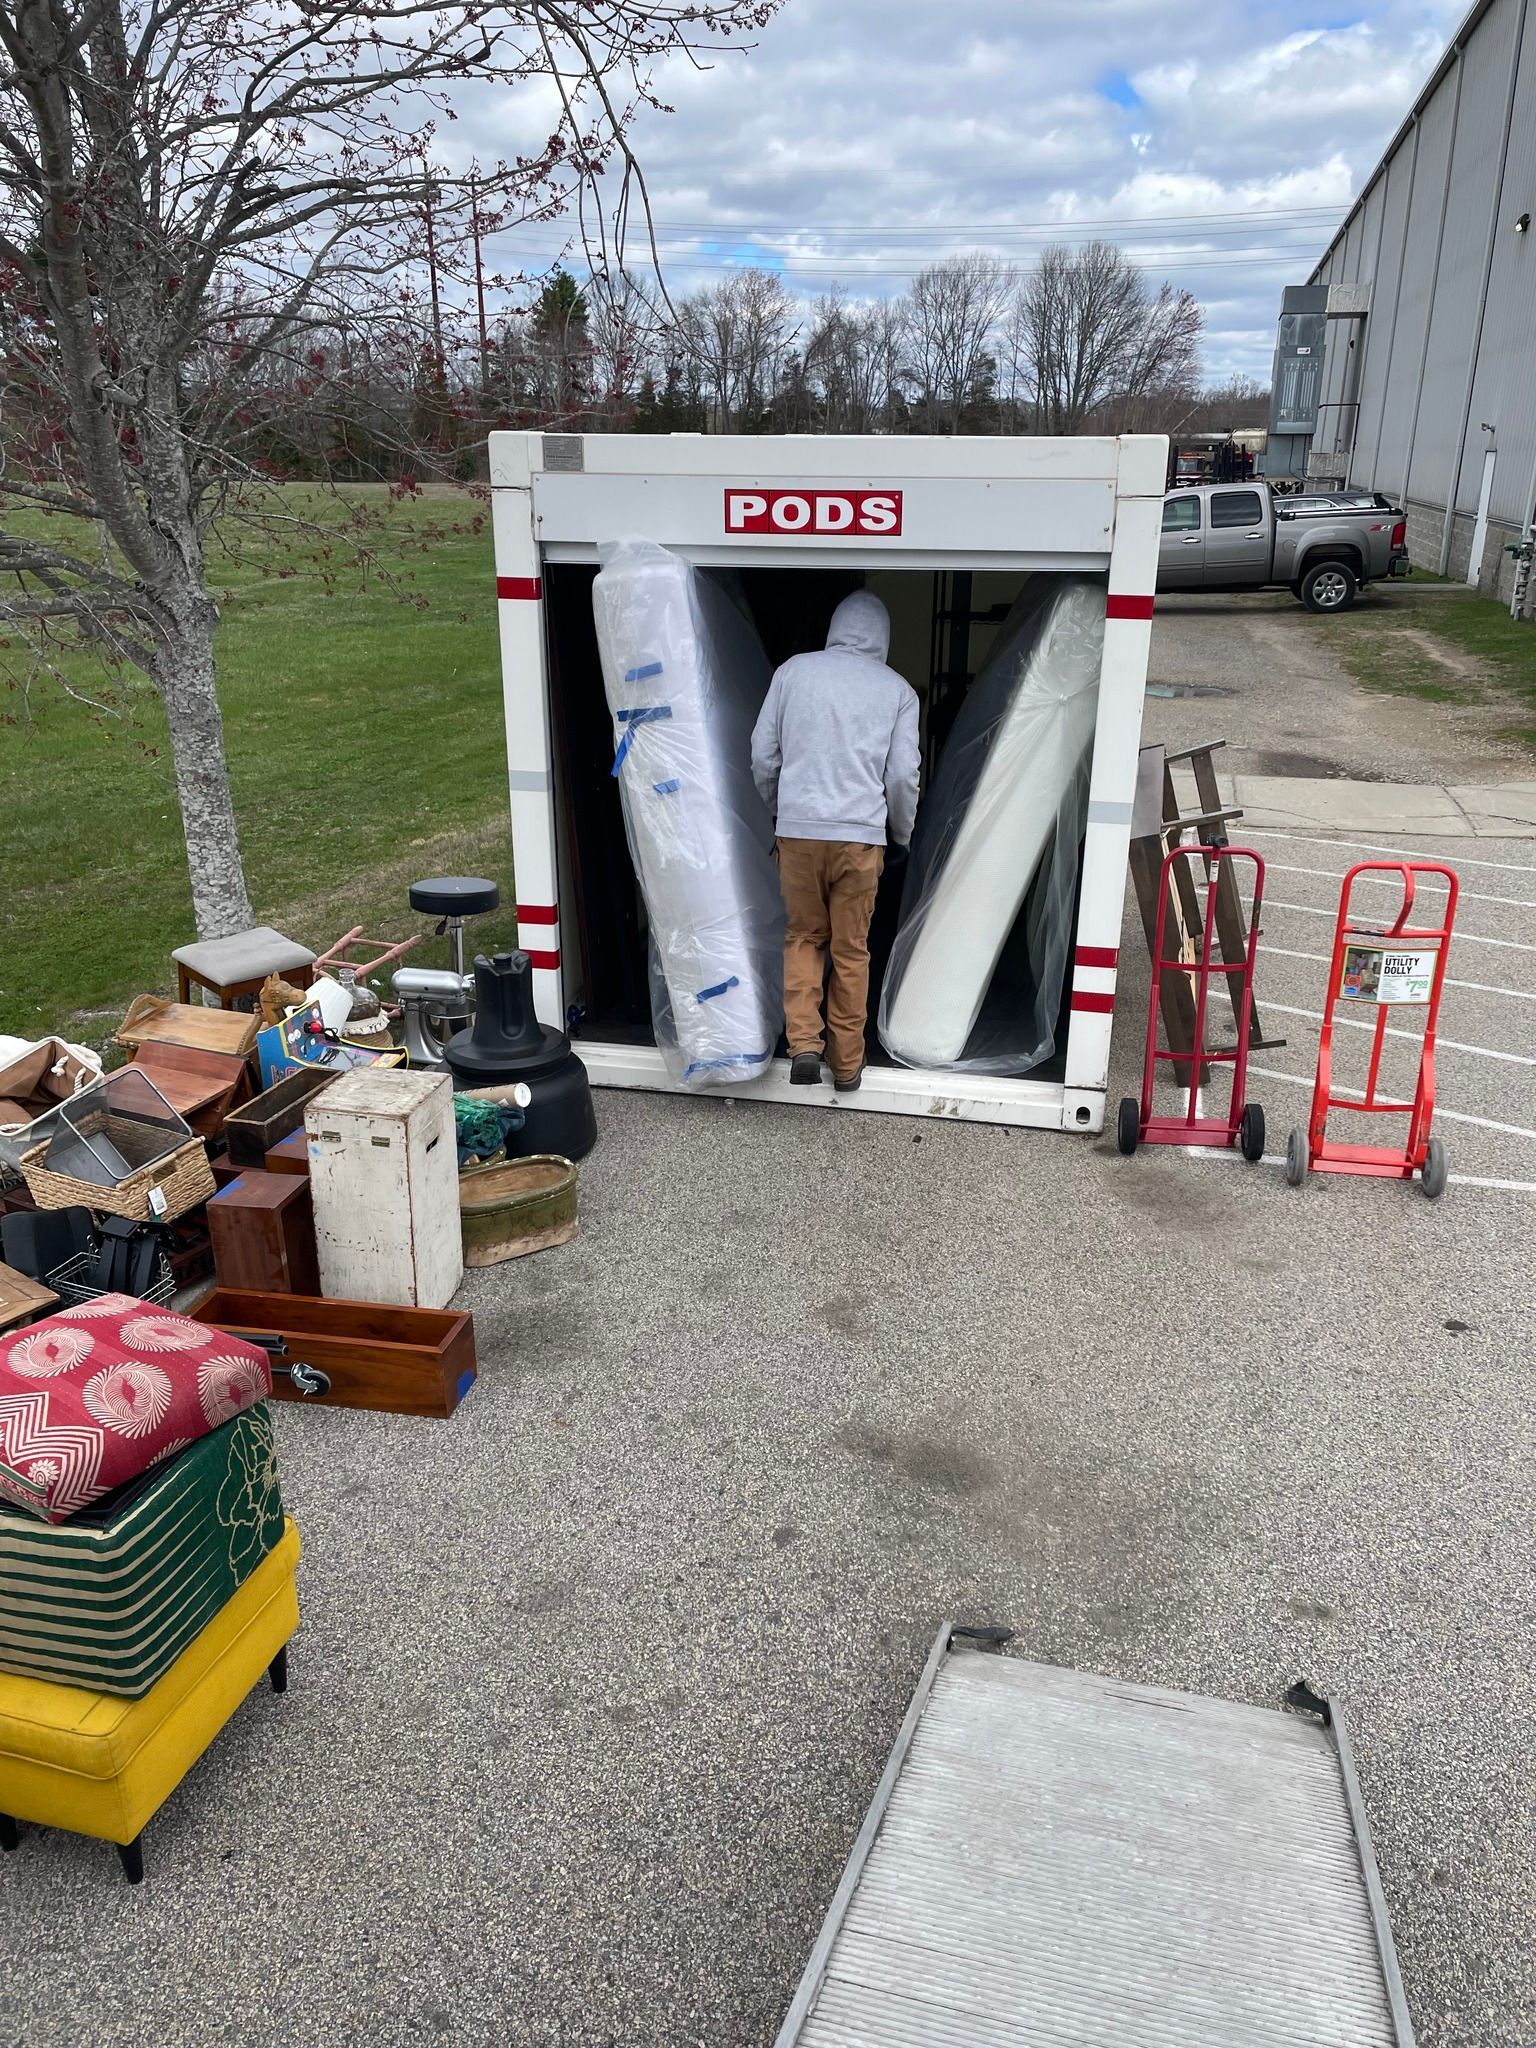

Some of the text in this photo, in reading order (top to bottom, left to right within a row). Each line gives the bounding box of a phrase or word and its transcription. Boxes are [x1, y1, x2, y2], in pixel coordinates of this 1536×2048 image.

[730, 495, 897, 531] PODS
[1385, 957, 1420, 966] UTILITY
[1384, 966, 1412, 974] DOLLY
